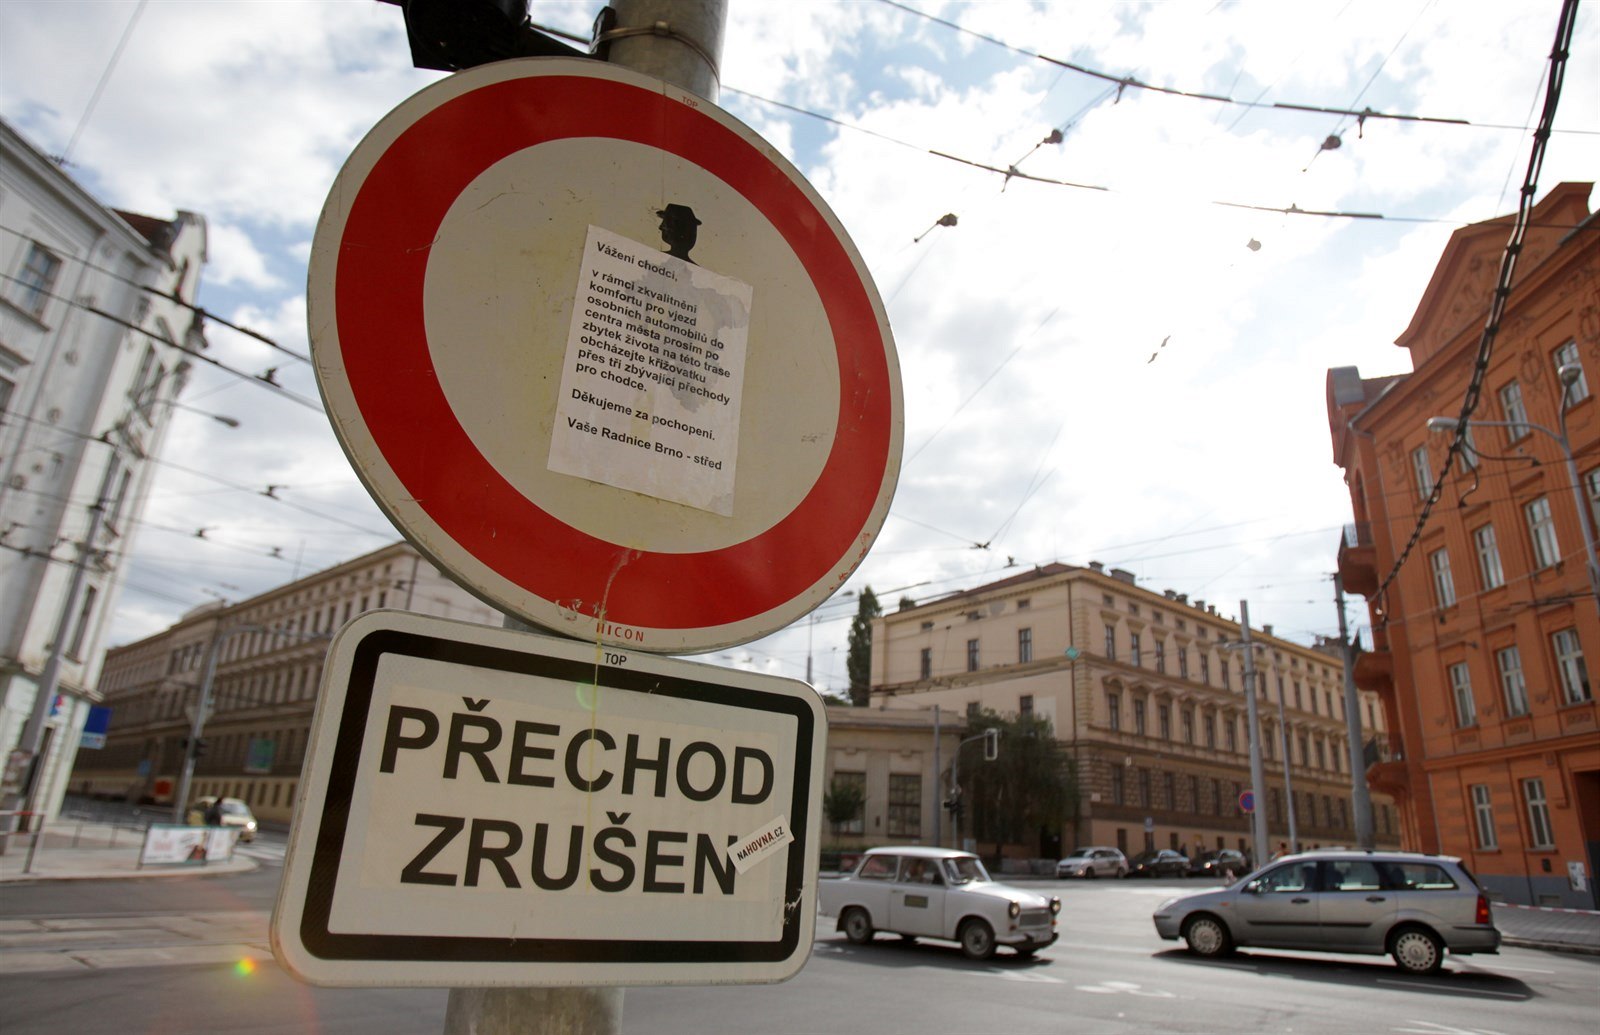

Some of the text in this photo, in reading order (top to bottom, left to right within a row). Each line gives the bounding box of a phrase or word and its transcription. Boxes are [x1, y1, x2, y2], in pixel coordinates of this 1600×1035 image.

[682, 96, 698, 108] TOP
[592, 268, 599, 278] v
[602, 272, 635, 291] rámci
[597, 240, 678, 282] Vážení chodci,
[587, 295, 725, 350] osobních automobilů do
[589, 279, 697, 327] komfortu pro vjezd
[582, 321, 731, 378] zbytek života na této trase
[585, 308, 720, 361] centra města prosím po
[576, 362, 647, 392] pro chodce.
[578, 348, 731, 406] přes tři zbývající přechody
[580, 335, 706, 384] obcházejte křižovatku
[571, 387, 632, 416] Děkujeme
[635, 409, 649, 421] za
[568, 416, 598, 435] Vaše
[601, 426, 652, 450] Radnice
[655, 441, 684, 459] Brno
[693, 454, 723, 471] střed
[605, 652, 627, 666] TOP
[379, 696, 774, 805] PŘECHOD
[400, 811, 739, 895] ZRUŠEN
[737, 826, 785, 861] NAHOVNA.CZ
